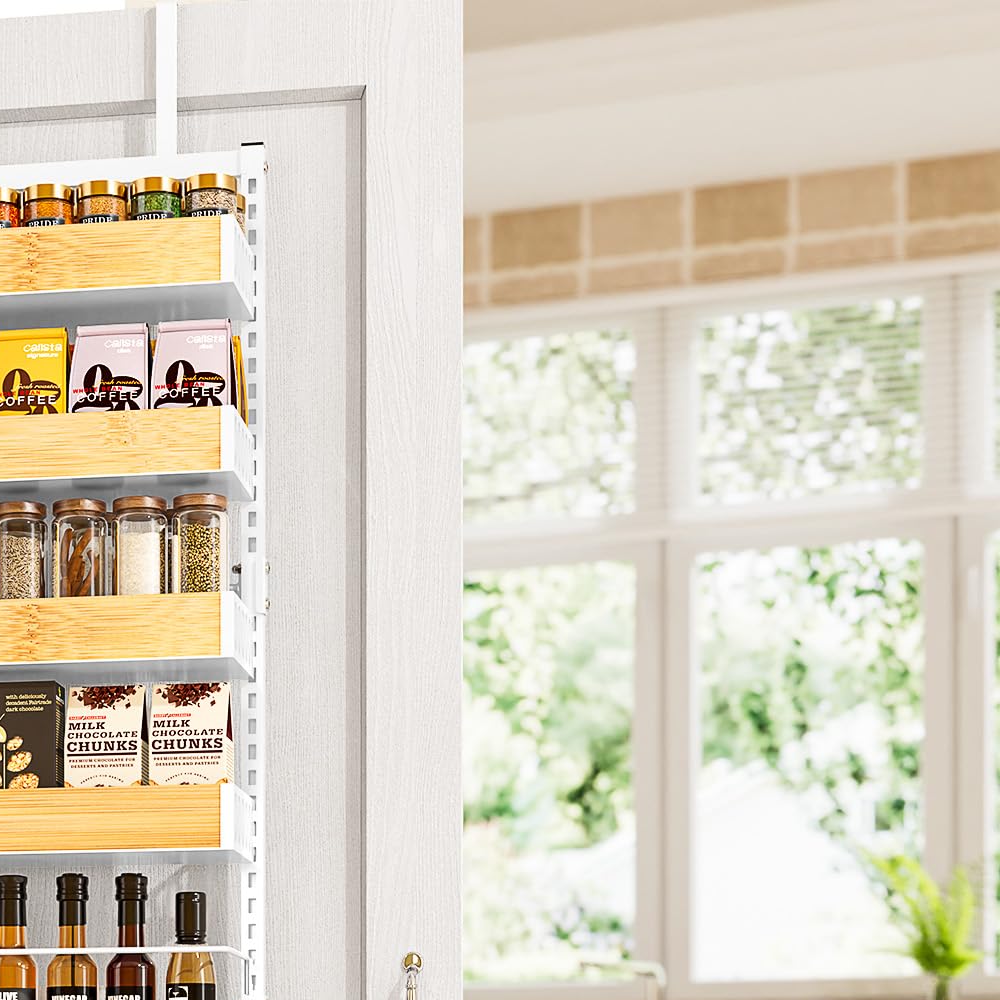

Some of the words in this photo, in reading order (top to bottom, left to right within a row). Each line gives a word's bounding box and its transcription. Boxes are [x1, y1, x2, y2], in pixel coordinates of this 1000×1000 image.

[137, 213, 168, 221] PRIDE
[192, 209, 222, 217] PRIDE
[29, 219, 59, 227] PRIDE
[83, 216, 113, 224] PRIDE
[77, 391, 138, 402] COFFEE
[159, 387, 221, 398] COFFEE
[68, 722, 106, 731] MILK
[153, 719, 190, 728] MILK
[67, 731, 138, 739] CHOCOLATE
[152, 729, 224, 737] CHOCOLATE
[67, 740, 138, 752] CHUNKS
[152, 738, 223, 750] CHUNKS
